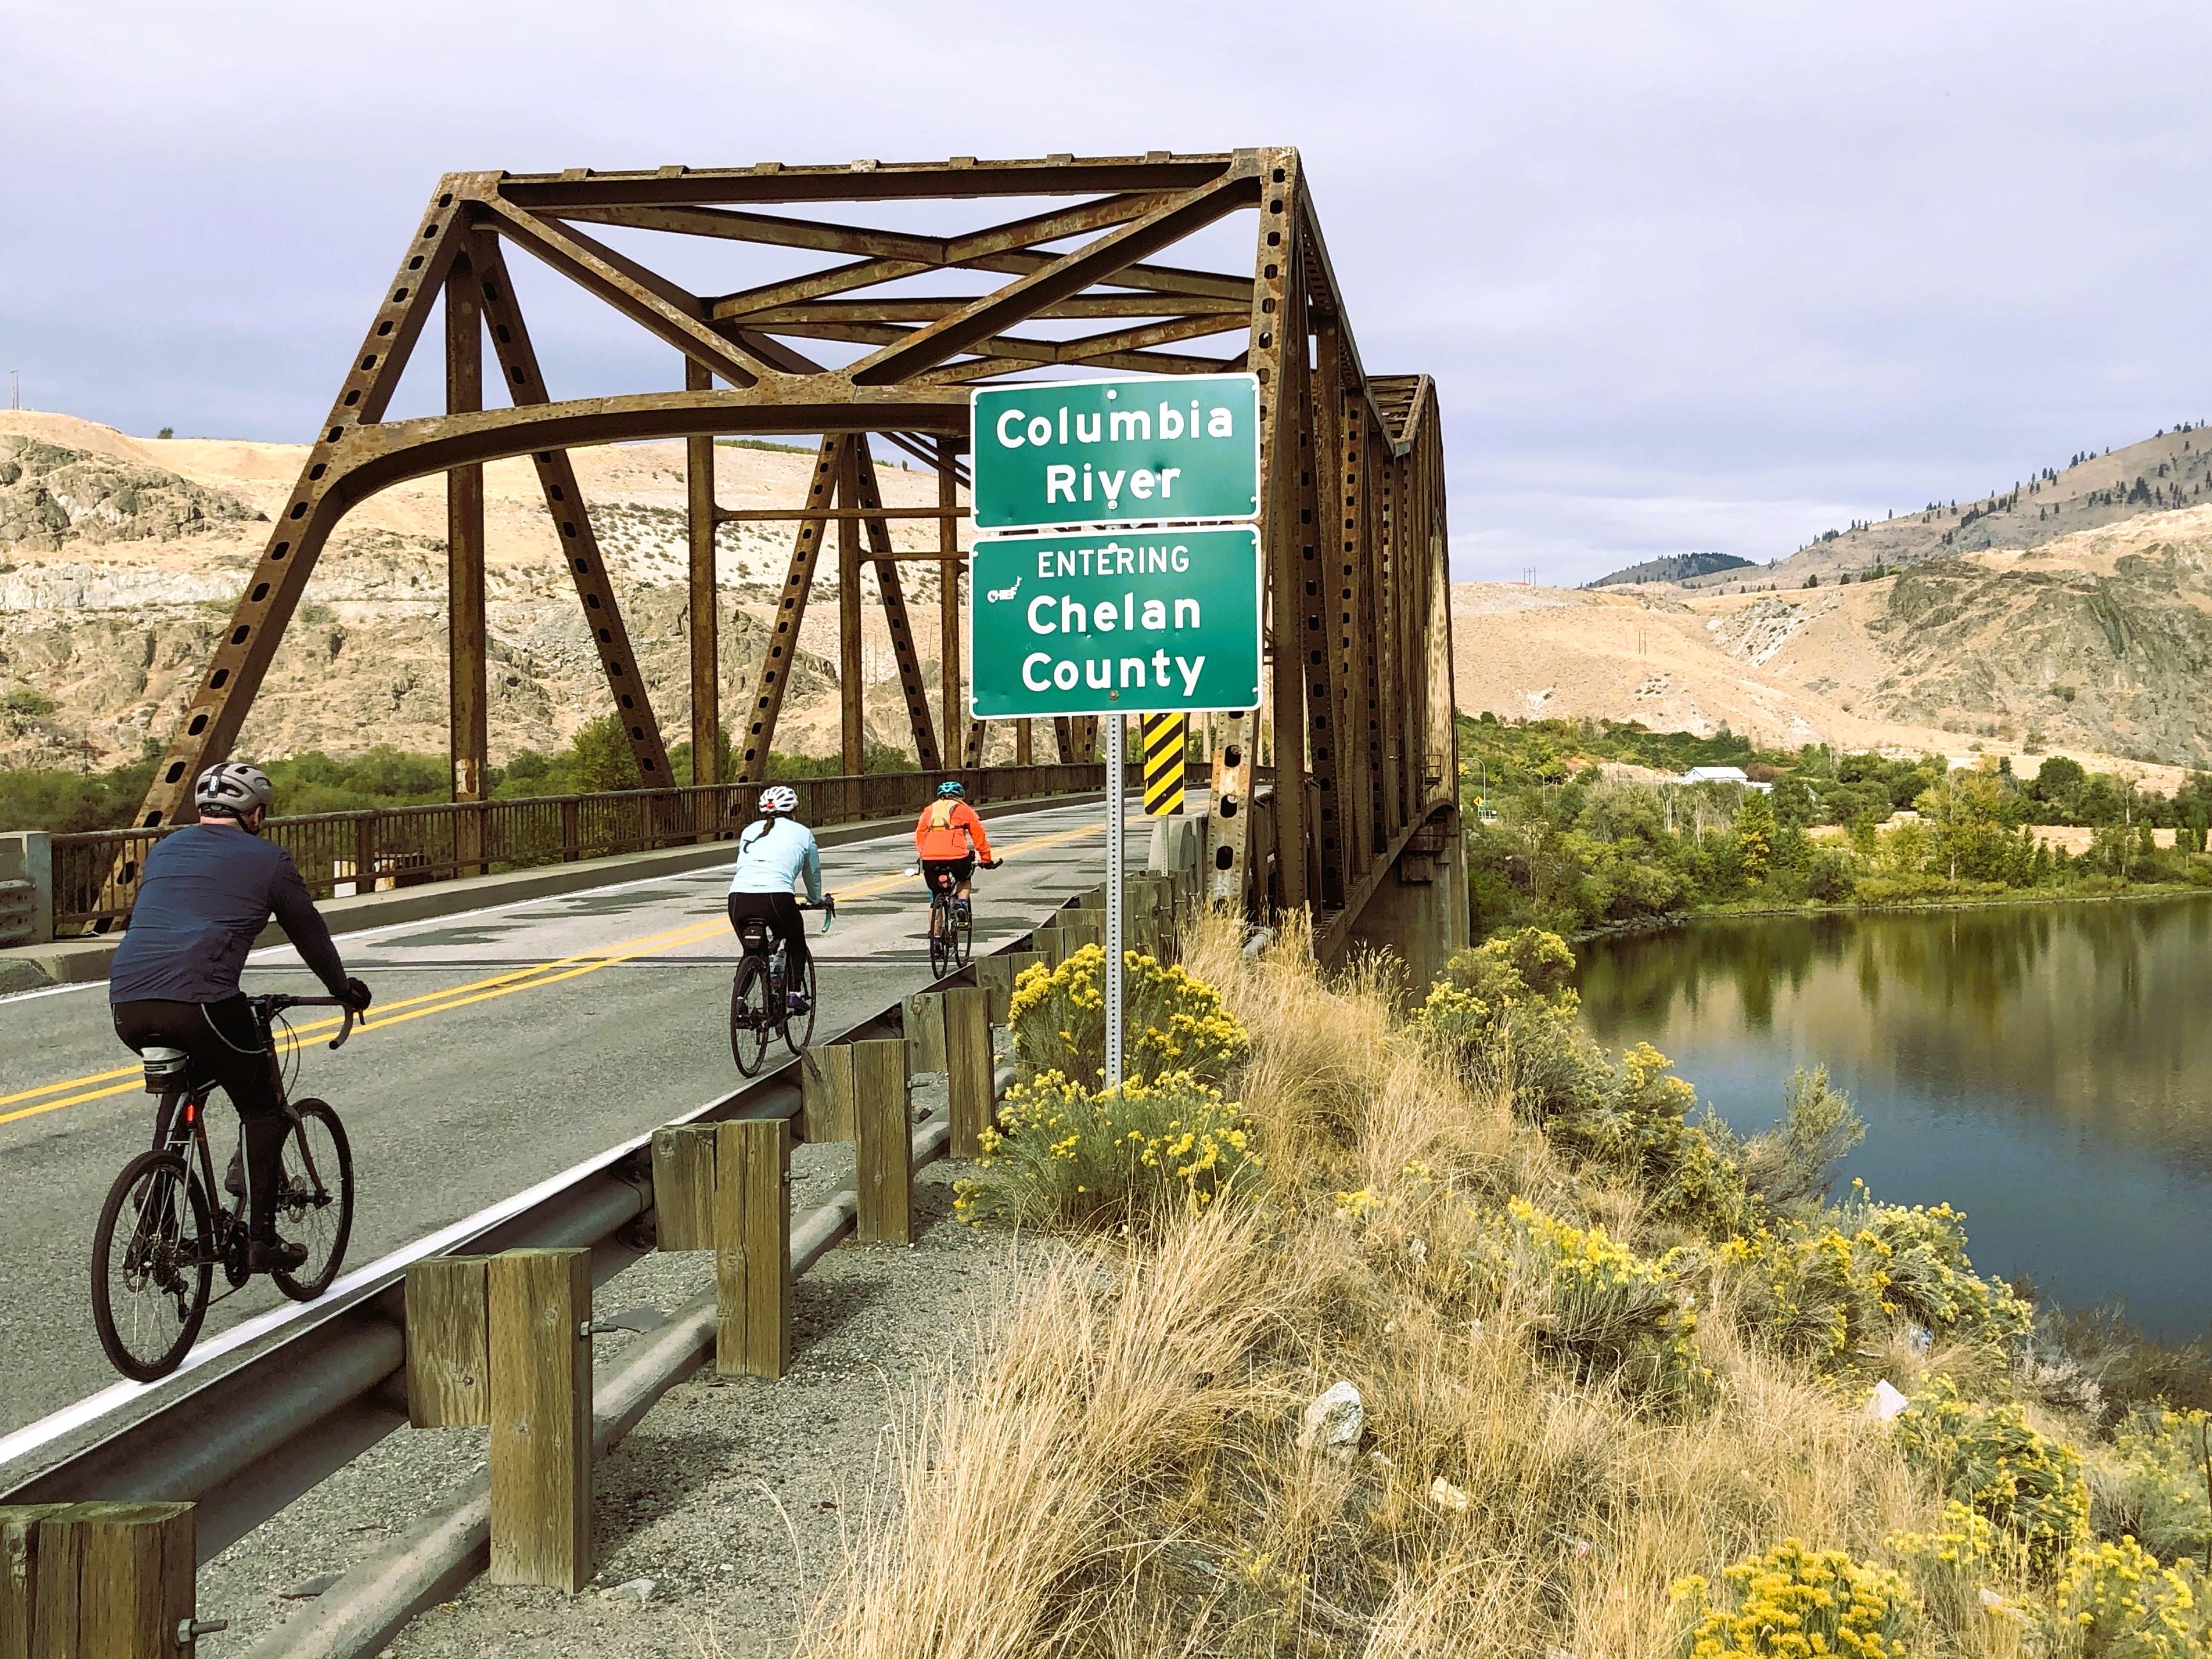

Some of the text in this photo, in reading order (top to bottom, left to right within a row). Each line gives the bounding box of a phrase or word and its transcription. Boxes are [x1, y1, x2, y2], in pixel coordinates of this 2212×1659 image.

[997, 400, 1233, 448] Columbia
[1047, 463, 1181, 504] River
[1038, 545, 1190, 578] ENTERING
[1027, 592, 1201, 635] Chelan
[1022, 648, 1206, 696] County
